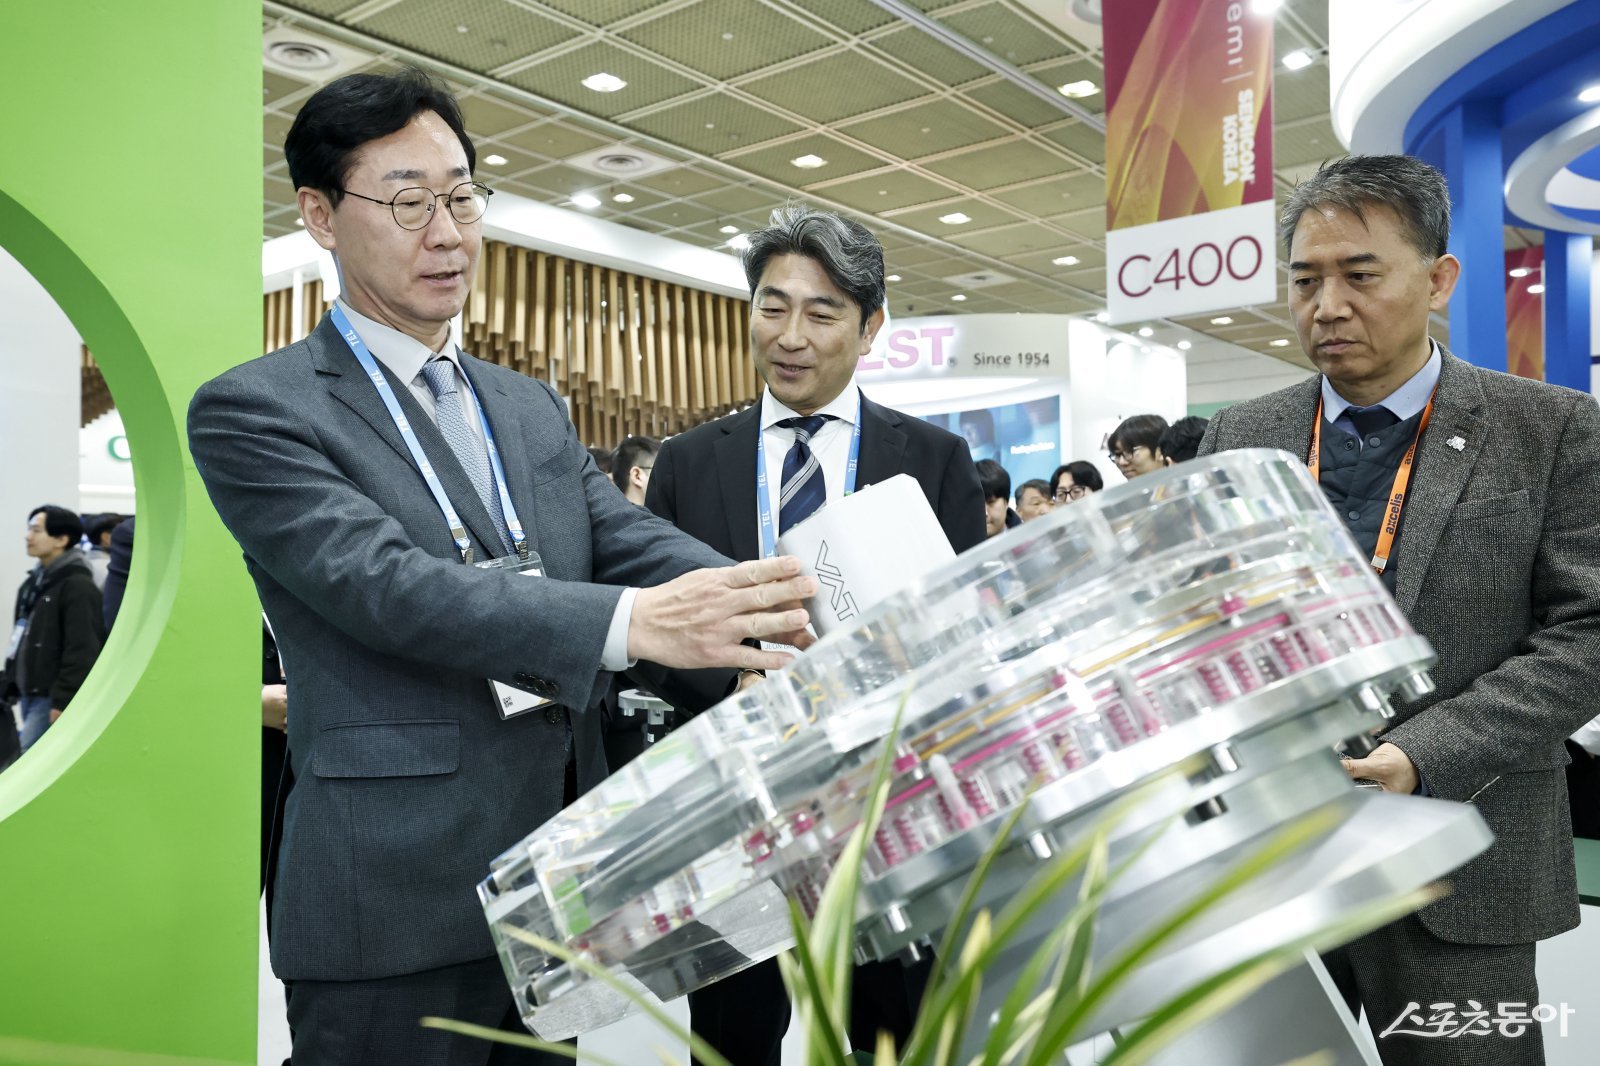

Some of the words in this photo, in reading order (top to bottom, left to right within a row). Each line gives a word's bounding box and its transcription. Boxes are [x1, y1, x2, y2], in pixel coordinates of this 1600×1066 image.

[1226, 0, 1244, 66] emi
[1237, 88, 1255, 182] SEMICON
[1222, 115, 1238, 186] KOREA
[1117, 234, 1263, 298] C400
[345, 329, 360, 347] TEL
[973, 352, 1012, 366] Since
[1017, 352, 1050, 366] 1954
[370, 369, 386, 388] TEL
[395, 413, 410, 432] TEL
[847, 458, 858, 473] TEL
[757, 472, 766, 488] TEL
[761, 510, 770, 527] TEL
[1385, 493, 1404, 536] axcelis
